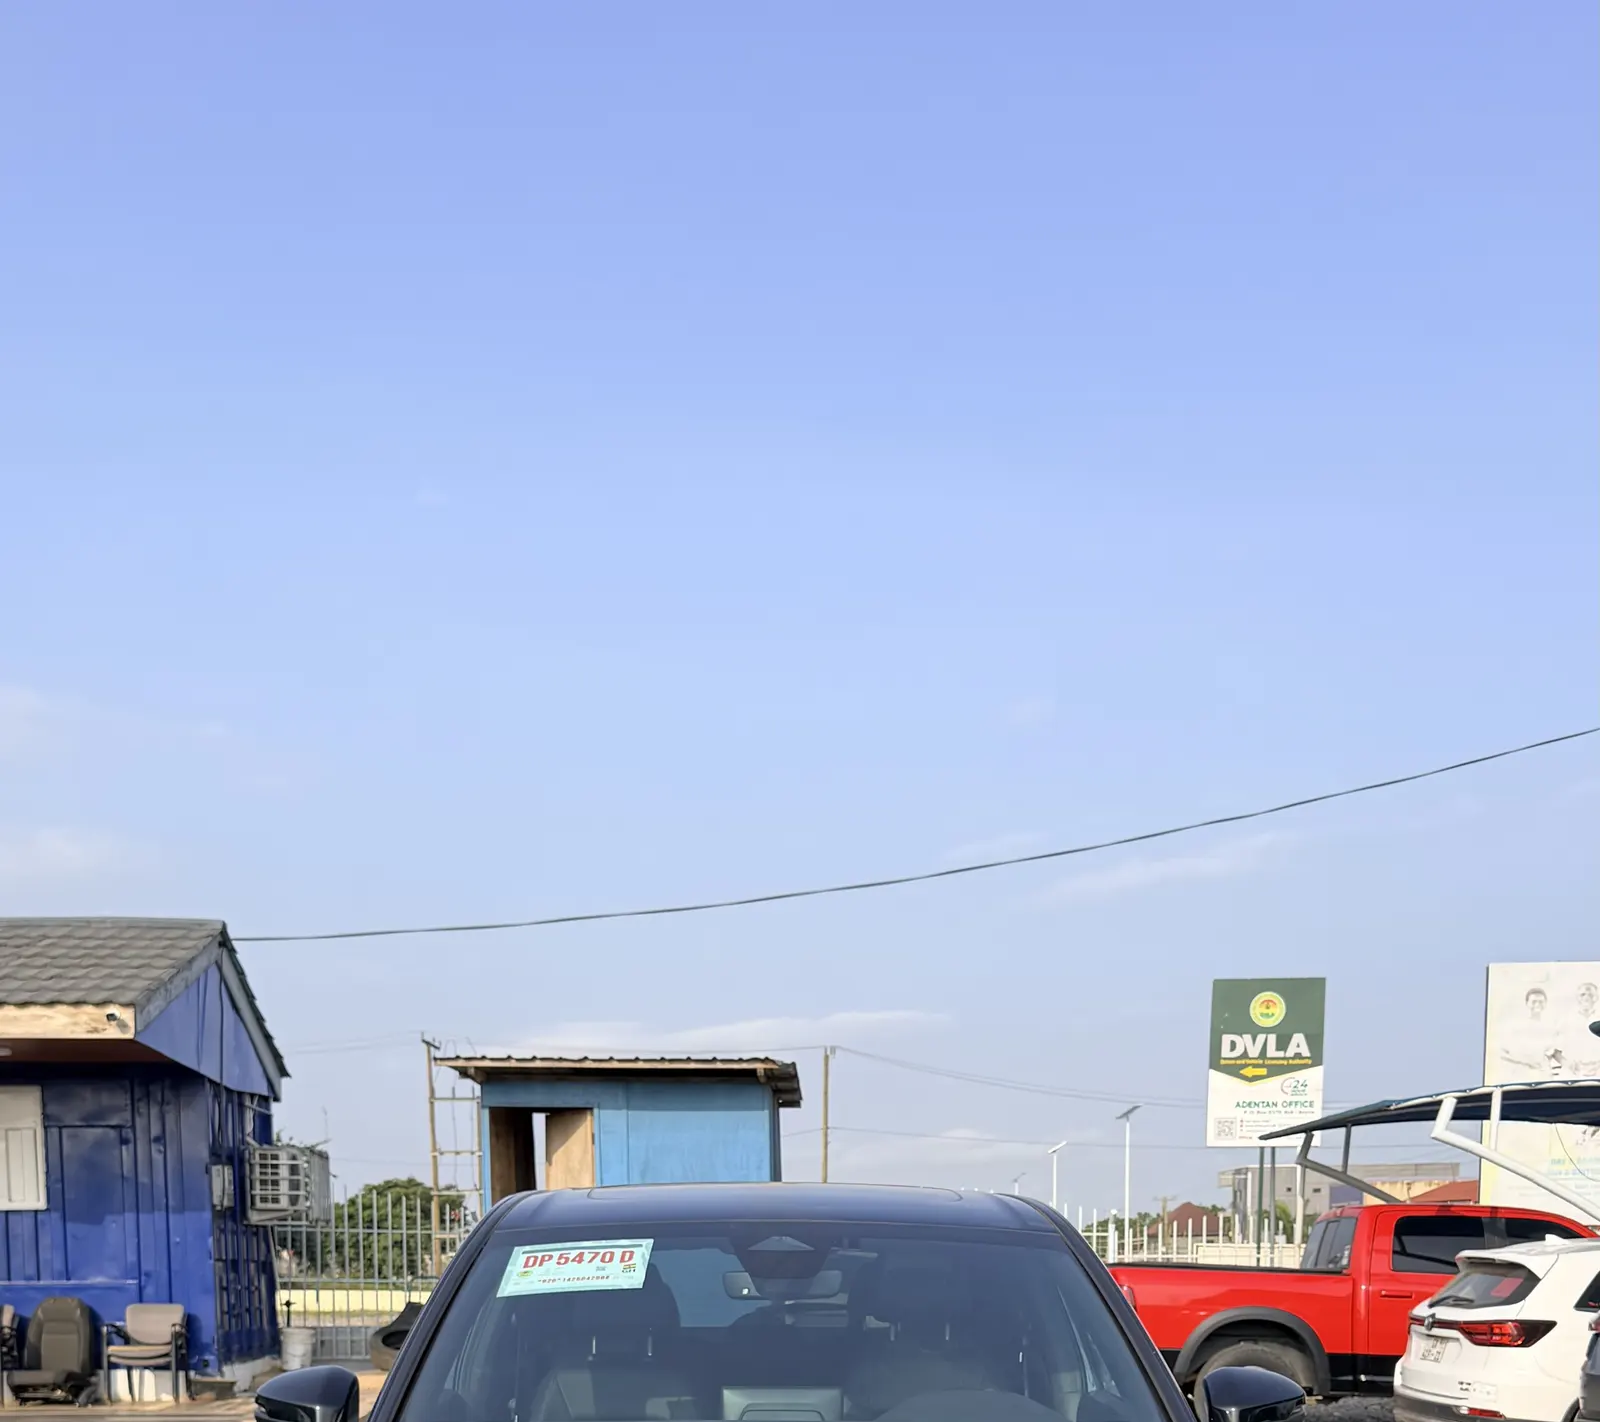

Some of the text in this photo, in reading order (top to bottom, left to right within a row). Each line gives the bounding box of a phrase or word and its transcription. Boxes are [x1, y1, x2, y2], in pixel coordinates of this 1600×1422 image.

[1221, 1033, 1311, 1058] DVLA
[1292, 1079, 1308, 1089] 24
[1235, 1100, 1315, 1109] ADENTAN OFFICE
[523, 1250, 635, 1269] DP 5470 D
